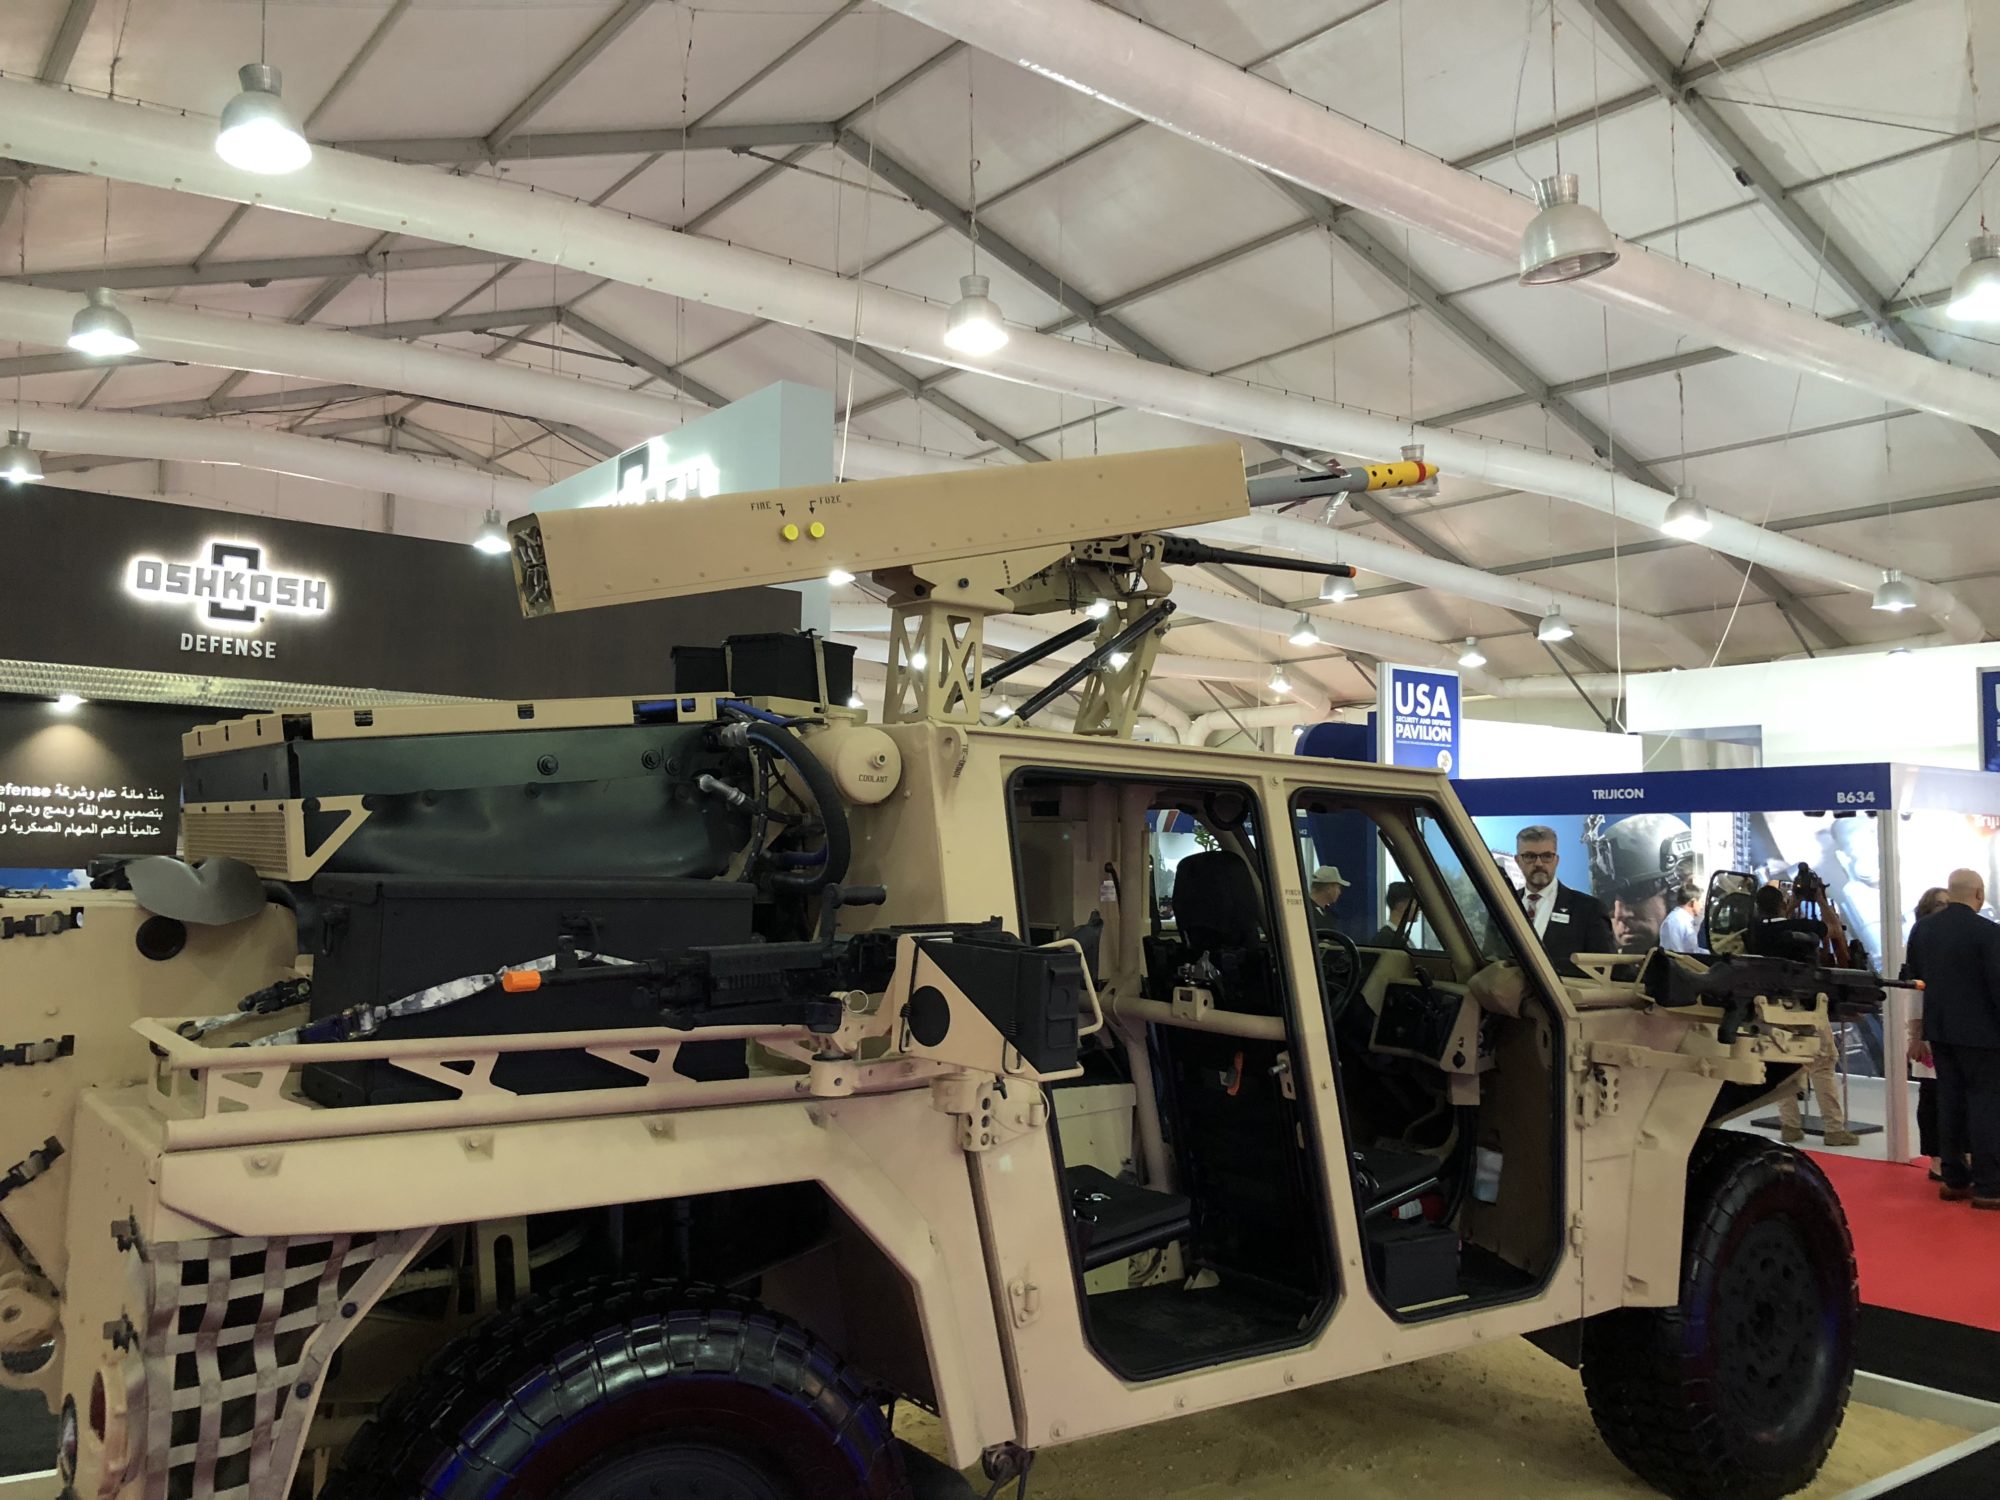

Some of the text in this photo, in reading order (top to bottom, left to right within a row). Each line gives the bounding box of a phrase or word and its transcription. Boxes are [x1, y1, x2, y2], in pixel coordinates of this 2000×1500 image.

[750, 501, 772, 511] FIRE
[819, 495, 842, 505] FUZE
[136, 560, 327, 610] OSHKOSH
[180, 632, 277, 659] DEFENSE
[1395, 681, 1451, 718] USA
[1395, 723, 1452, 743] PAVILION
[858, 774, 888, 783] COOLANT
[54, 782, 95, 801] وشركة
[97, 788, 117, 801] عام
[147, 788, 165, 800] منذ
[1592, 788, 1644, 800] TRIJICON
[1837, 791, 1875, 803] B634
[8, 803, 40, 817] ودعم
[43, 805, 75, 819] ودمج
[123, 807, 164, 821] بتصميم
[10, 818, 61, 834] العسكرية
[64, 822, 98, 837] المهام
[100, 824, 127, 838] لدعم
